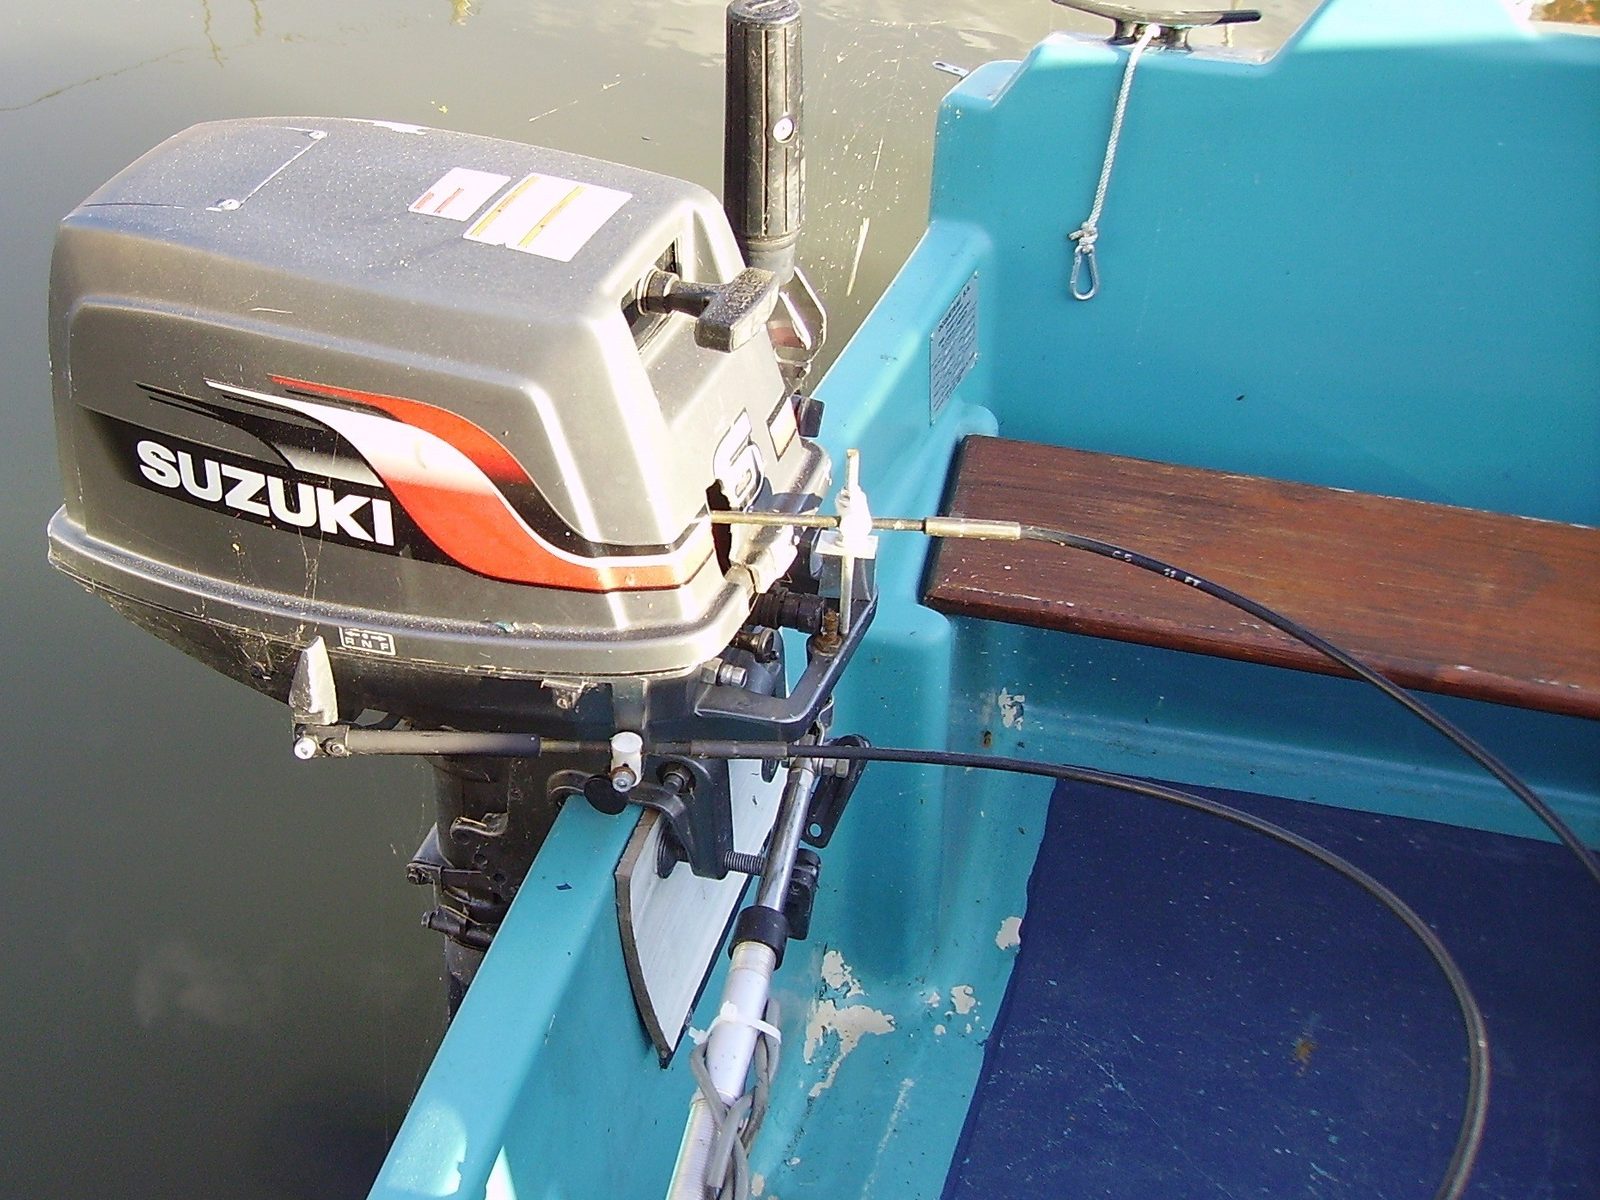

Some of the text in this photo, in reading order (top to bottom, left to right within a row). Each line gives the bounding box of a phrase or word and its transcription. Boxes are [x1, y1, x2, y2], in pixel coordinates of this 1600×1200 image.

[136, 440, 395, 547] SUZUKI
[361, 639, 373, 649] N
[380, 642, 389, 651] F
